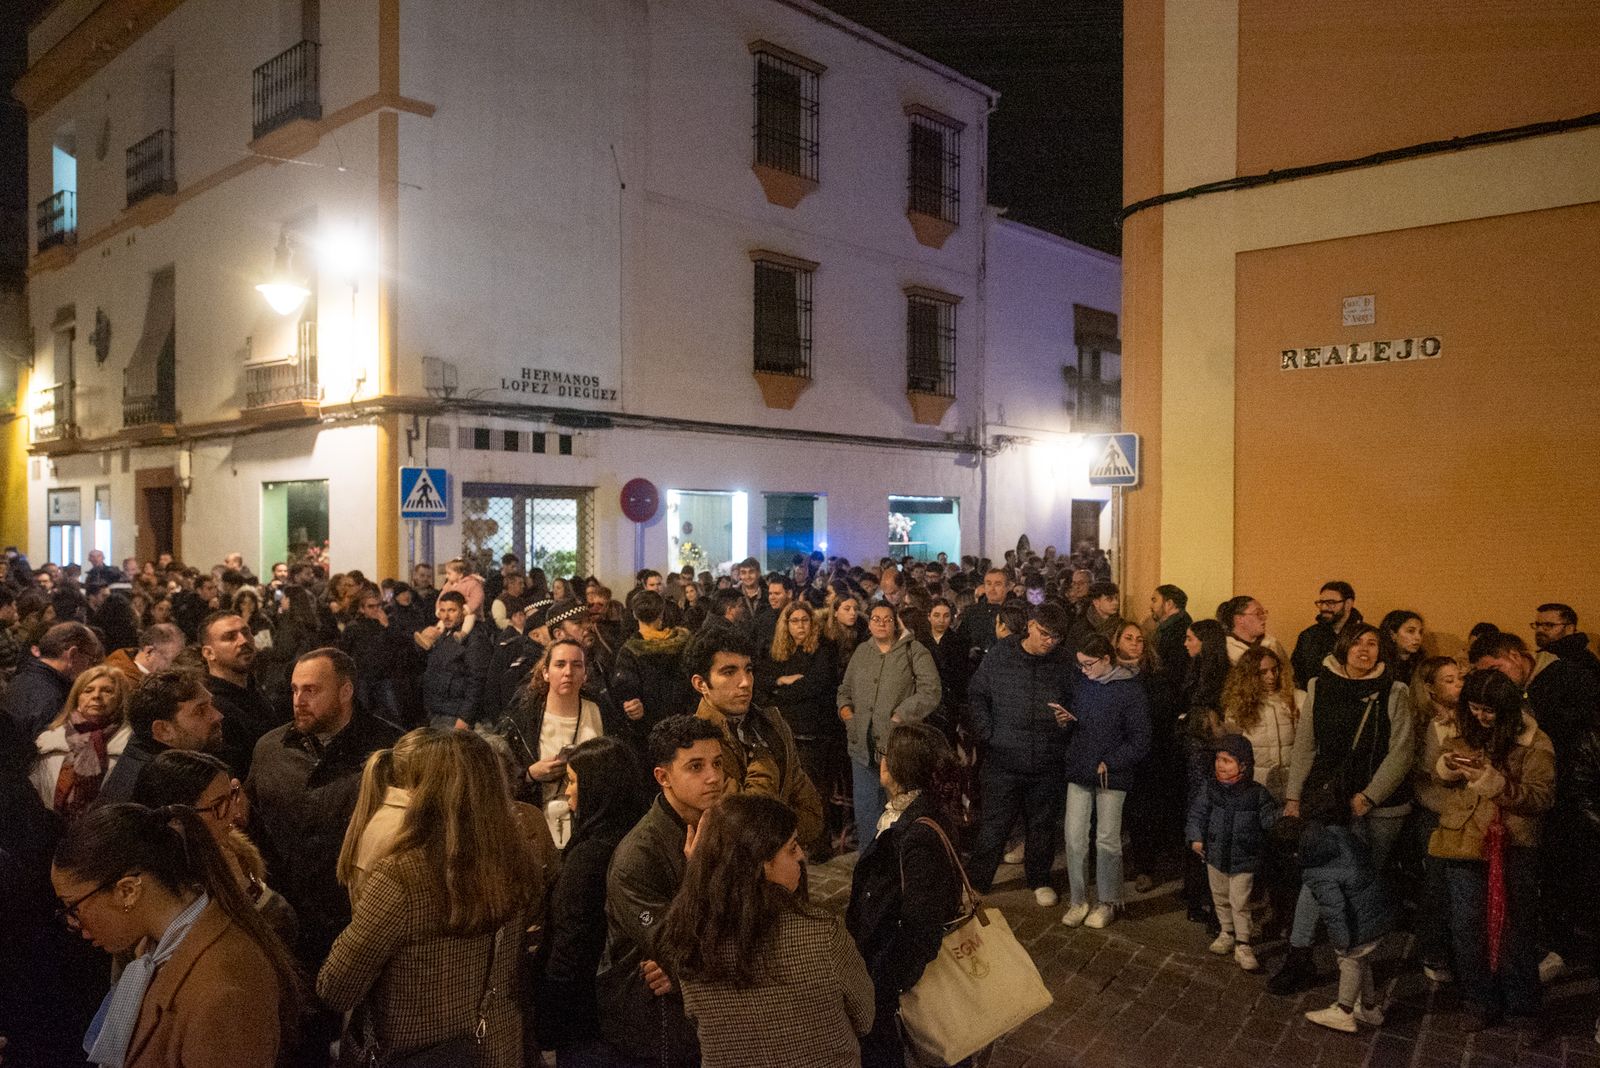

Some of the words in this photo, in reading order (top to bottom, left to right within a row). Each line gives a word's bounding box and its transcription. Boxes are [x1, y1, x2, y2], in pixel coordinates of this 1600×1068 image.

[1281, 337, 1441, 369] REALEJO
[522, 368, 599, 387] HERMANOS
[501, 378, 549, 394] LOPEZ
[558, 386, 617, 401] DIEGUEZ
